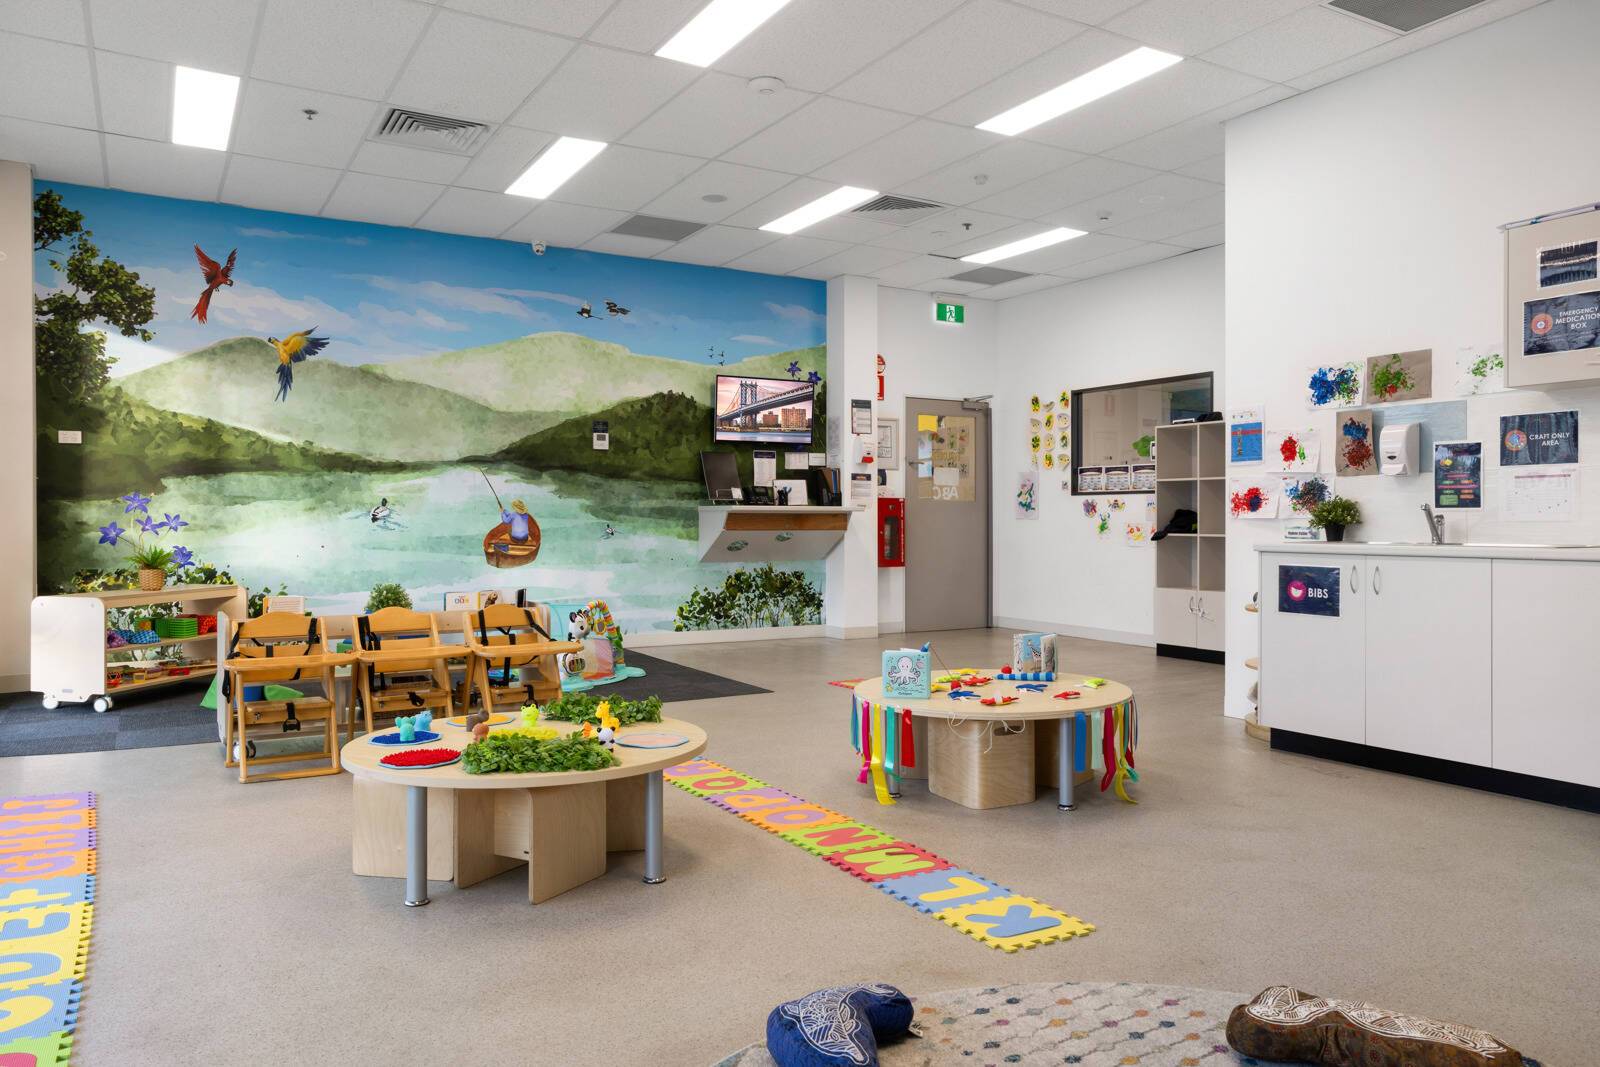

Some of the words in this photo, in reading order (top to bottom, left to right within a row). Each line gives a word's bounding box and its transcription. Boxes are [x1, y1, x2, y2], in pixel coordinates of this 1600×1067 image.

[1559, 306, 1599, 317] EMERGENCY
[1570, 321, 1587, 330] BOX
[1529, 433, 1550, 441] CRAFT
[1308, 587, 1329, 599] BIBS
